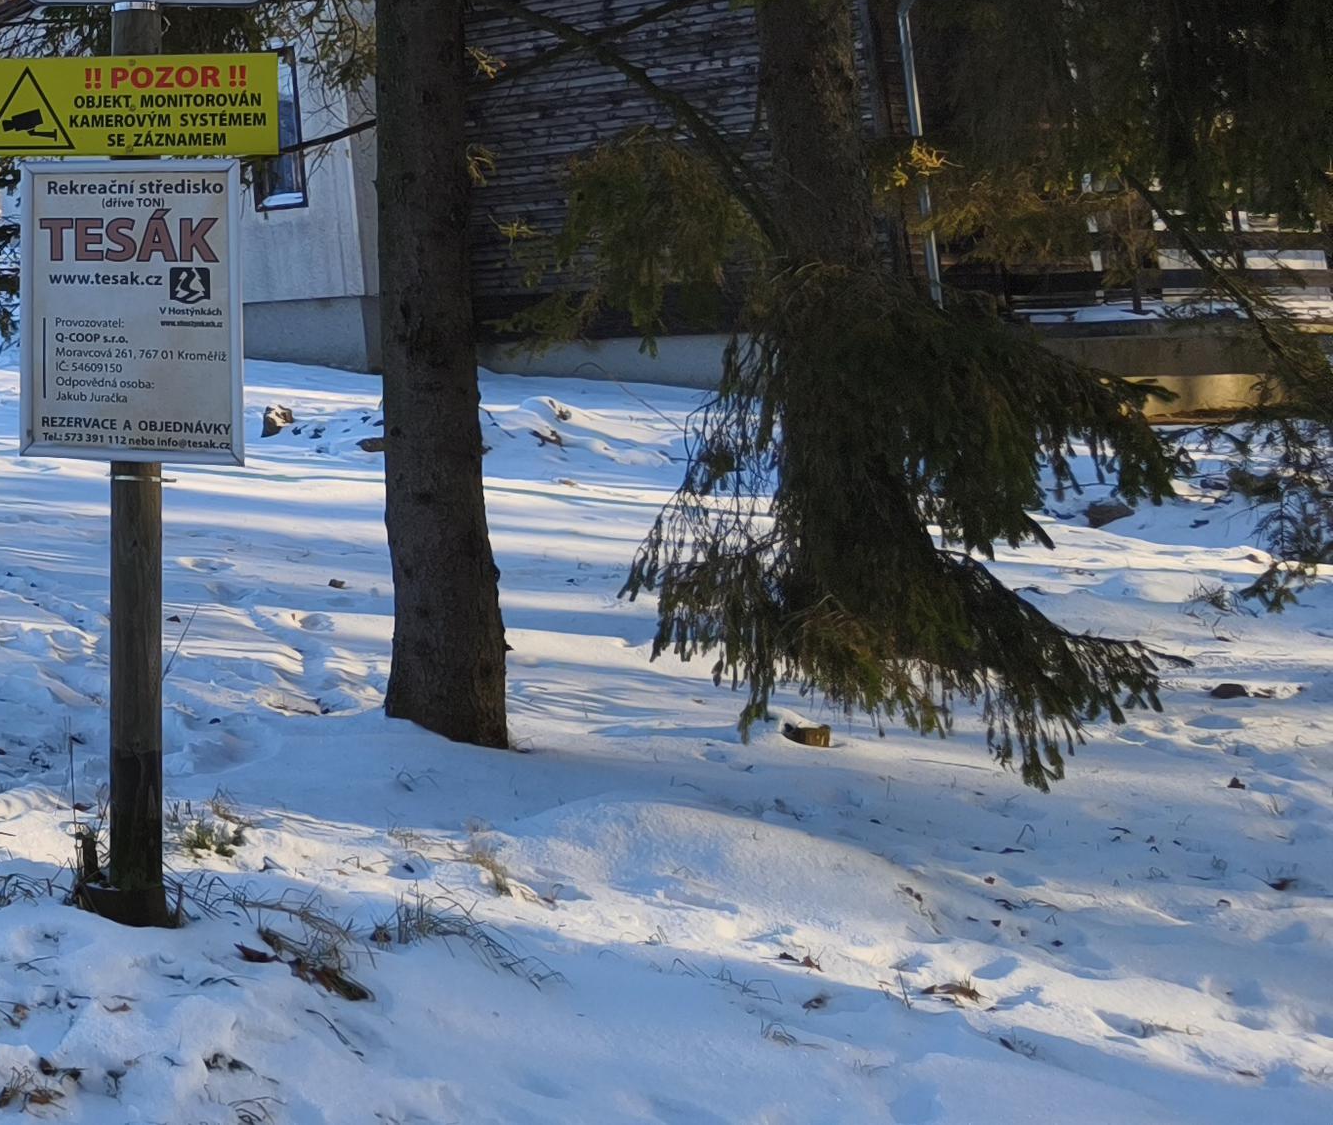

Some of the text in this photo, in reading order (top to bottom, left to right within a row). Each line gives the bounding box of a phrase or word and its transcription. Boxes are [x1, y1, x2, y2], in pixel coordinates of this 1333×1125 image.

[85, 65, 247, 90] !! POZOR !!
[74, 90, 261, 109] OBJEKT MONITOROVÁN
[69, 110, 267, 128] KAMEROVÝM SYSTÉMEM
[107, 130, 227, 147] SE ZÁZNAMEM
[47, 179, 224, 195] Rekreační středisko
[102, 197, 165, 209] (dříve TON)
[39, 208, 220, 263] TESÁK
[49, 272, 164, 286] www.tesak.cz
[159, 307, 222, 316] V Hostýnkách
[55, 317, 125, 328] Provozovatel:
[55, 332, 129, 344] Q-COOP s.r.o.
[55, 347, 228, 362] Moravcová 261, 767 01 Kroměříž
[71, 362, 123, 373] 54609150
[55, 376, 155, 390] Odpovědná osoba:
[55, 391, 88, 402] Jakub
[41, 416, 231, 435] REZERVACE A OBJEDNÁVKY
[64, 432, 83, 442] 573
[85, 434, 104, 443] 391
[108, 435, 126, 445] 112
[128, 436, 155, 446] nebo
[157, 437, 231, 449] info@tesak.cz
